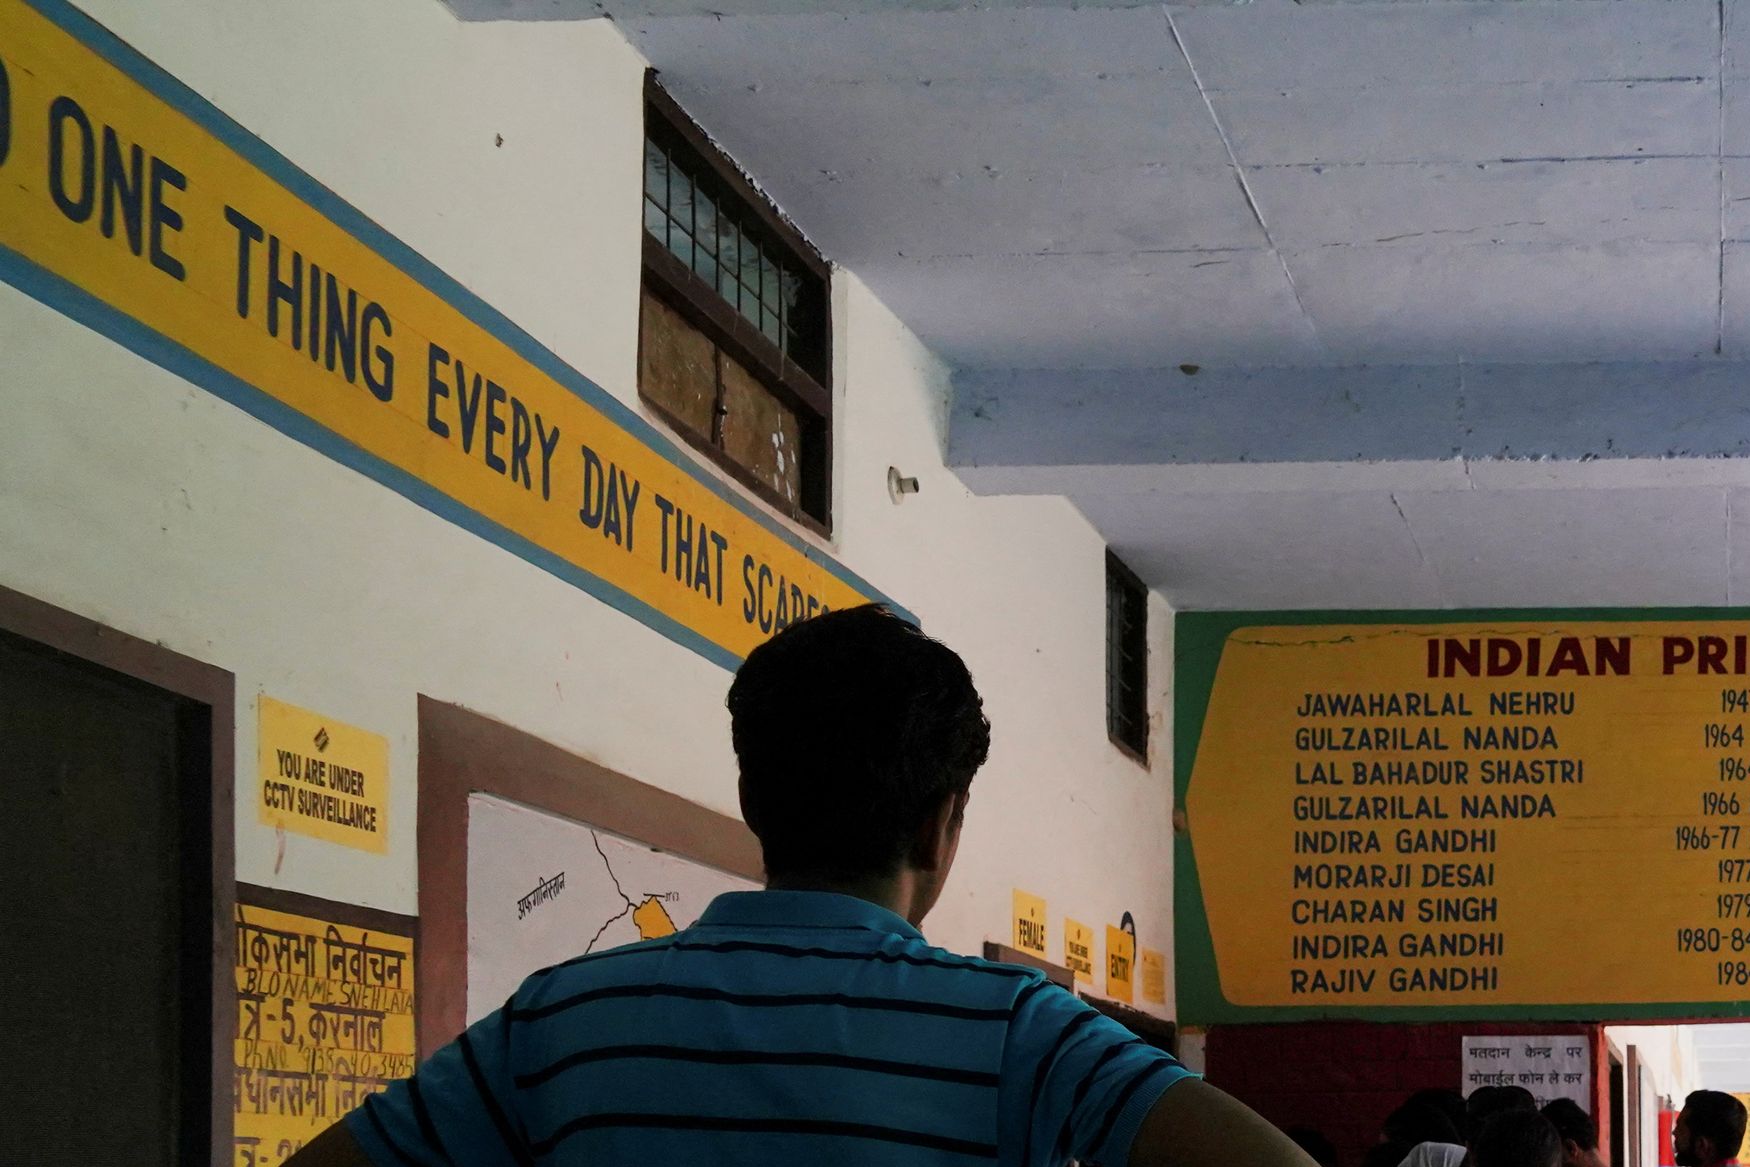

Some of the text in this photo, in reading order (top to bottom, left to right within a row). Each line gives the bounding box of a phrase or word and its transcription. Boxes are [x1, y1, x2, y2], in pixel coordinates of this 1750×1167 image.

[48, 95, 187, 282] ONE
[224, 204, 394, 402] THING
[428, 341, 560, 502] EVERY
[579, 444, 641, 552] DAY
[655, 493, 728, 606] THAT
[1427, 637, 1631, 678] INDIAN
[1296, 692, 1473, 718] JAWAHARLAL
[1489, 691, 1575, 716] NEHRU
[1295, 726, 1449, 752] GULZARILAL
[1463, 725, 1559, 751] NANDA
[1703, 723, 1745, 748] 1964
[276, 748, 365, 798] YOU ARE UNDER
[1295, 761, 1344, 786] LAL
[1351, 759, 1469, 786] BAHADUR
[1480, 759, 1584, 785] SHASTRI
[264, 779, 377, 833] CCTV SURVEILLANCE
[1293, 795, 1449, 822] GULZARILAL
[1460, 793, 1557, 819] NANDA
[1701, 791, 1741, 816] 1966
[1294, 830, 1382, 855] INDIRA
[1395, 828, 1496, 854] GANDHI
[1293, 863, 1411, 890] MORARJI
[1420, 862, 1495, 888] DESAI
[1291, 899, 1405, 925] CHARAN
[1418, 896, 1498, 924] SINGH
[1018, 917, 1045, 952] FEMALE
[1292, 934, 1389, 960] INDIRA
[1398, 932, 1504, 958] GANDHI
[324, 924, 407, 989] निर्वाचन
[1290, 968, 1376, 994] RAJIV
[1389, 966, 1498, 992] GANDHI
[308, 1002, 386, 1053] करनाल
[1469, 1047, 1510, 1059] मतदान
[1566, 1046, 1583, 1058] पर
[1519, 1068, 1545, 1085] फोन
[1549, 1069, 1560, 1084] ले
[1563, 1072, 1583, 1085] कर
